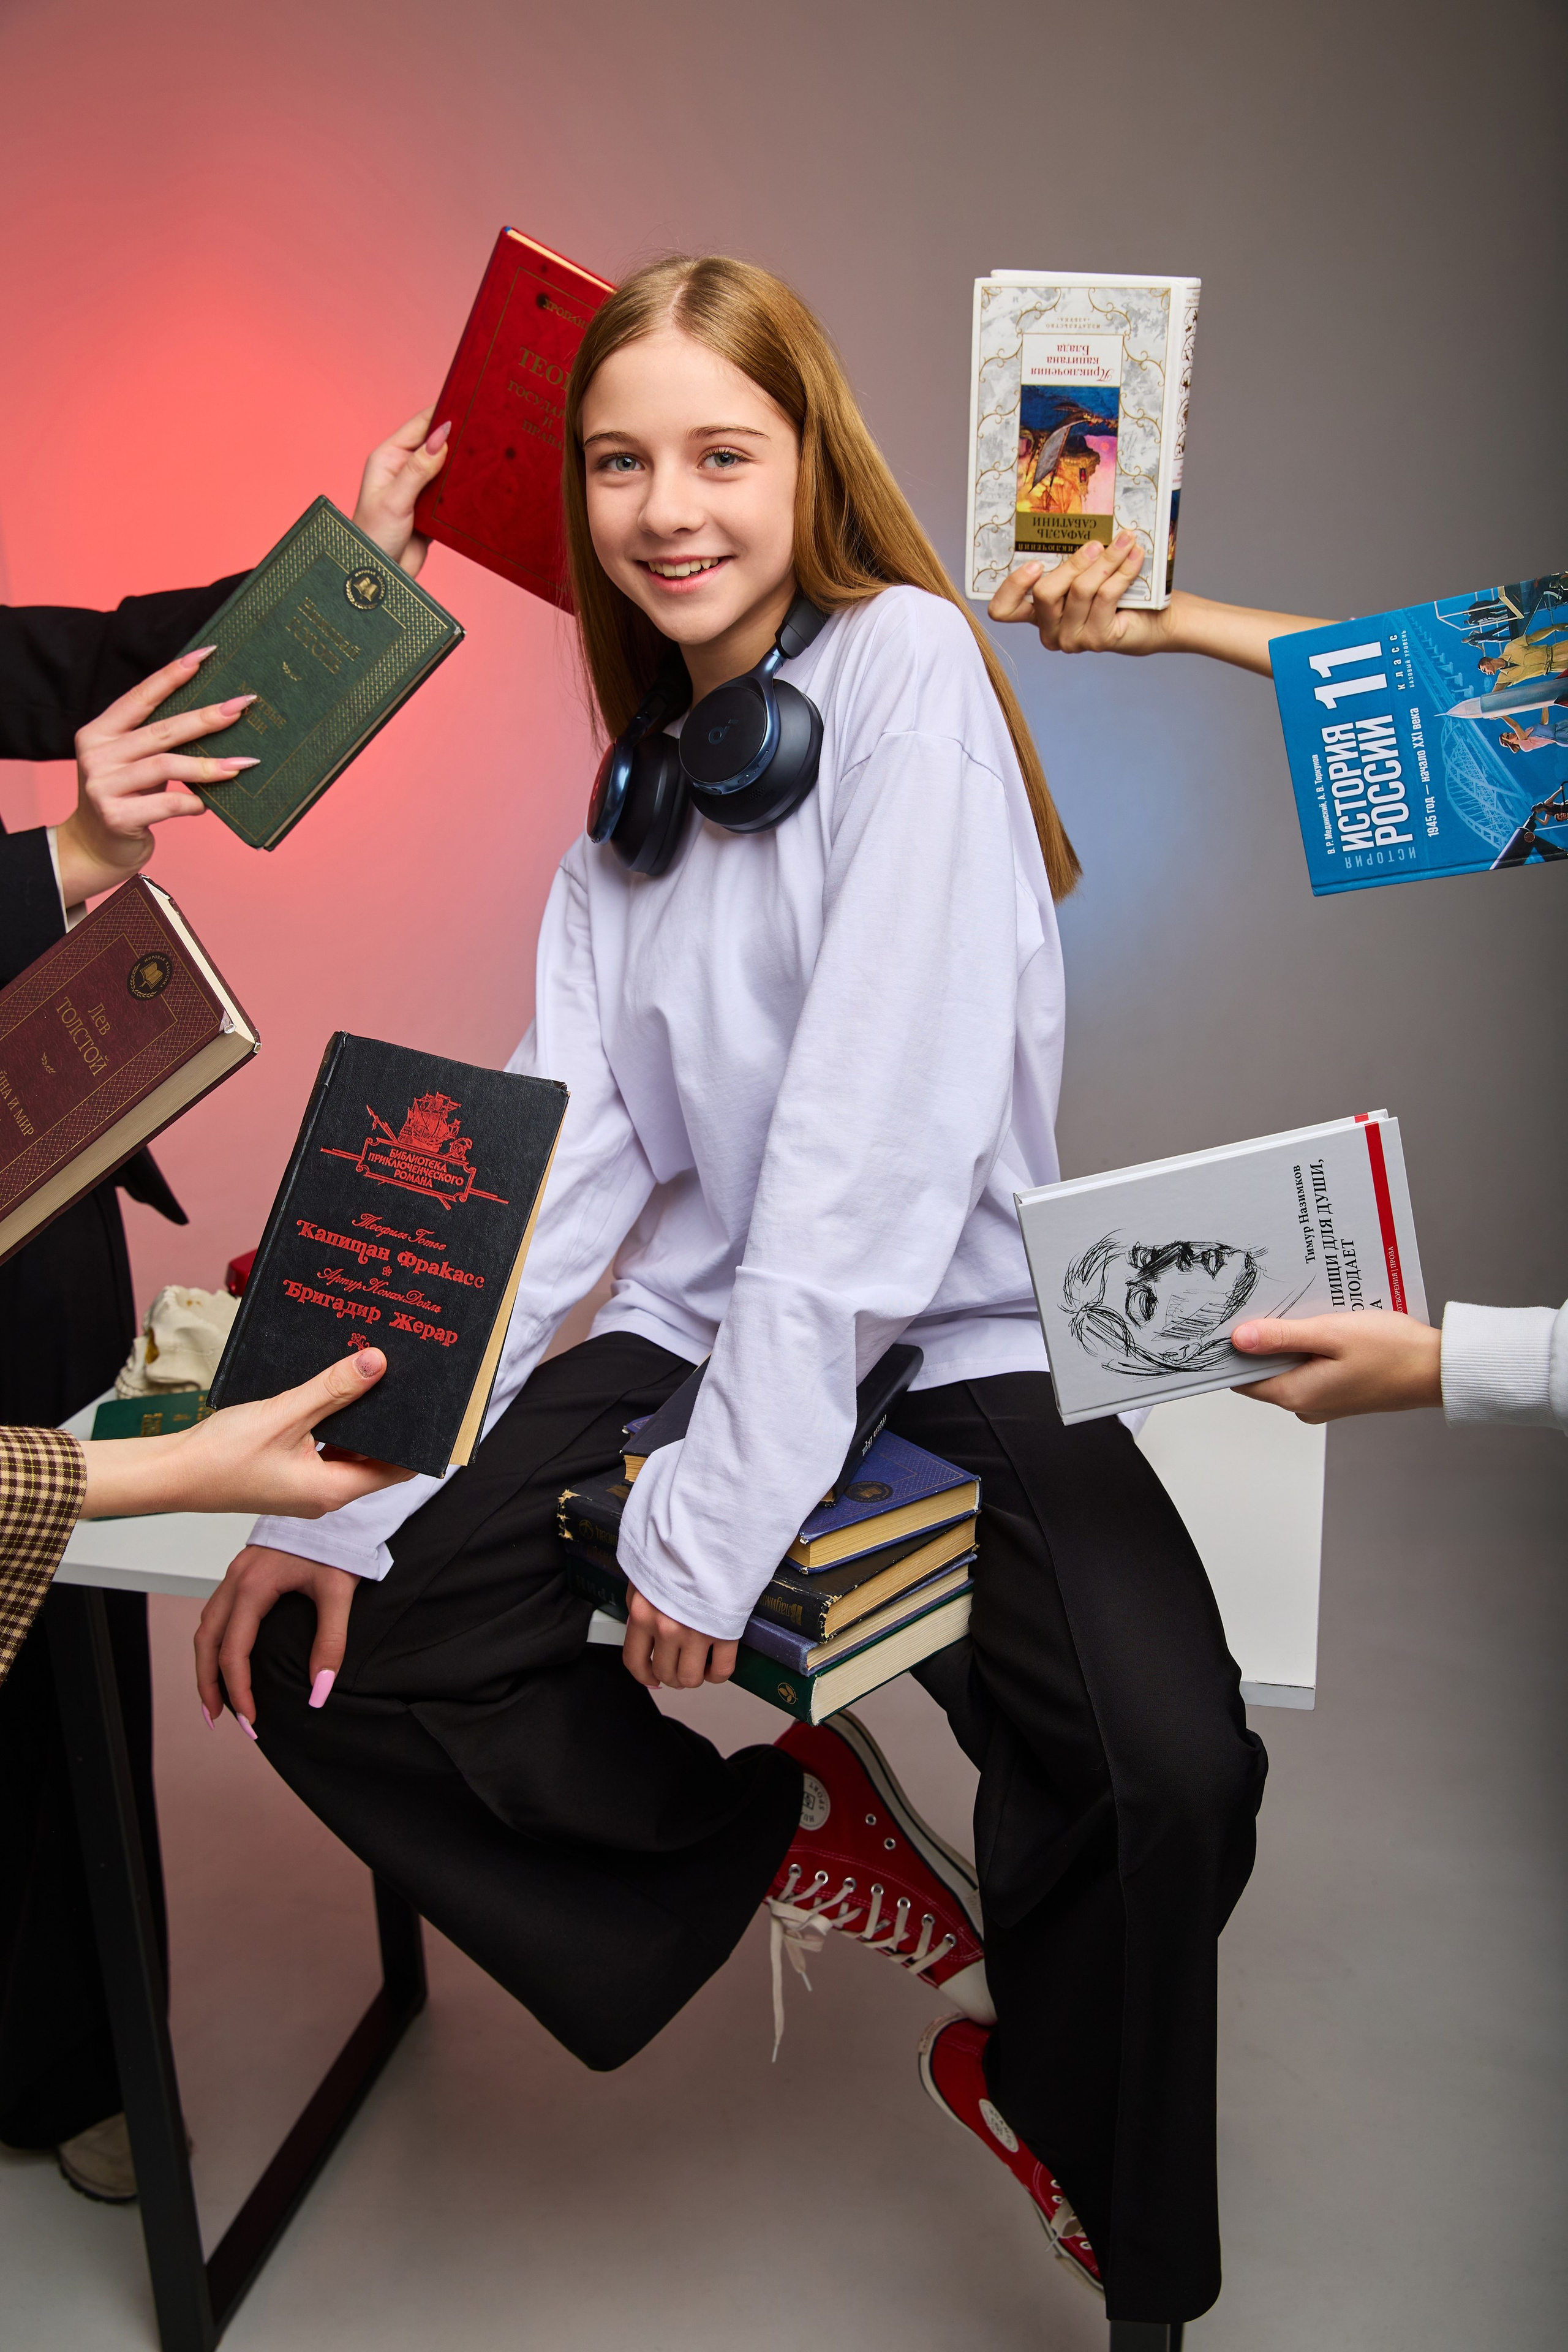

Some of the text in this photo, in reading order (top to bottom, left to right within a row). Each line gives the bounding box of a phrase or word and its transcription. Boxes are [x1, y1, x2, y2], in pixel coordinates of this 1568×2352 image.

[543, 298, 589, 331] ХРОПАН
[1057, 344, 1089, 355] Блада
[1031, 366, 1115, 382] Приключения
[508, 380, 565, 419] ГОСУДАР
[1033, 517, 1097, 529] САБАТИНИ
[1037, 529, 1091, 540] РАФАЭЛЬ
[1018, 543, 1079, 552] РИКЛЮЧЕНИЙ
[285, 616, 342, 674] ГОГОЛЬ
[298, 597, 361, 662] Николай
[1309, 641, 1387, 709] 11
[1401, 630, 1415, 688] БАЗОВЫЙ УРОВЕНЬ
[1409, 707, 1422, 730] века
[1411, 731, 1425, 748] XXI
[1312, 754, 1323, 785] Торкунов
[1355, 715, 1413, 846] РОССИИ
[1417, 750, 1430, 783] начало
[1321, 722, 1374, 852] ИСТОРИЯ
[1319, 801, 1333, 840] Мединский,
[1425, 796, 1436, 813] год
[1425, 815, 1439, 837] 1945
[1344, 846, 1416, 869] ИСТОРИЯ
[56, 997, 110, 1076] ТОЛСТОЙ
[88, 1003, 111, 1036] Лев
[0, 1070, 34, 1136] ЙНА И МИР
[368, 1152, 464, 1186] ПРИКЛЮЧЕНЧЕСКОГО
[389, 1148, 448, 1173] БИБЛИОТЕКА
[394, 1169, 433, 1188] РОМАНА
[1293, 1164, 1316, 1264] Тимур Назимков
[352, 1213, 447, 1251] Теофиль Готье
[1310, 1159, 1345, 1306] ПИЩИ ДЛЯ ДУШИ,
[296, 1219, 485, 1289] Капитан Фракасс
[1388, 1246, 1397, 1268] ПРОЗА
[317, 1267, 442, 1313] Артур Конан Дойль
[1341, 1239, 1365, 1311] ОЛОДАЕТ
[1393, 1272, 1404, 1313] ОТВОРЕНИЯ
[283, 1279, 458, 1347] Бригадир Жерар
[760, 1594, 802, 1626] Владими
